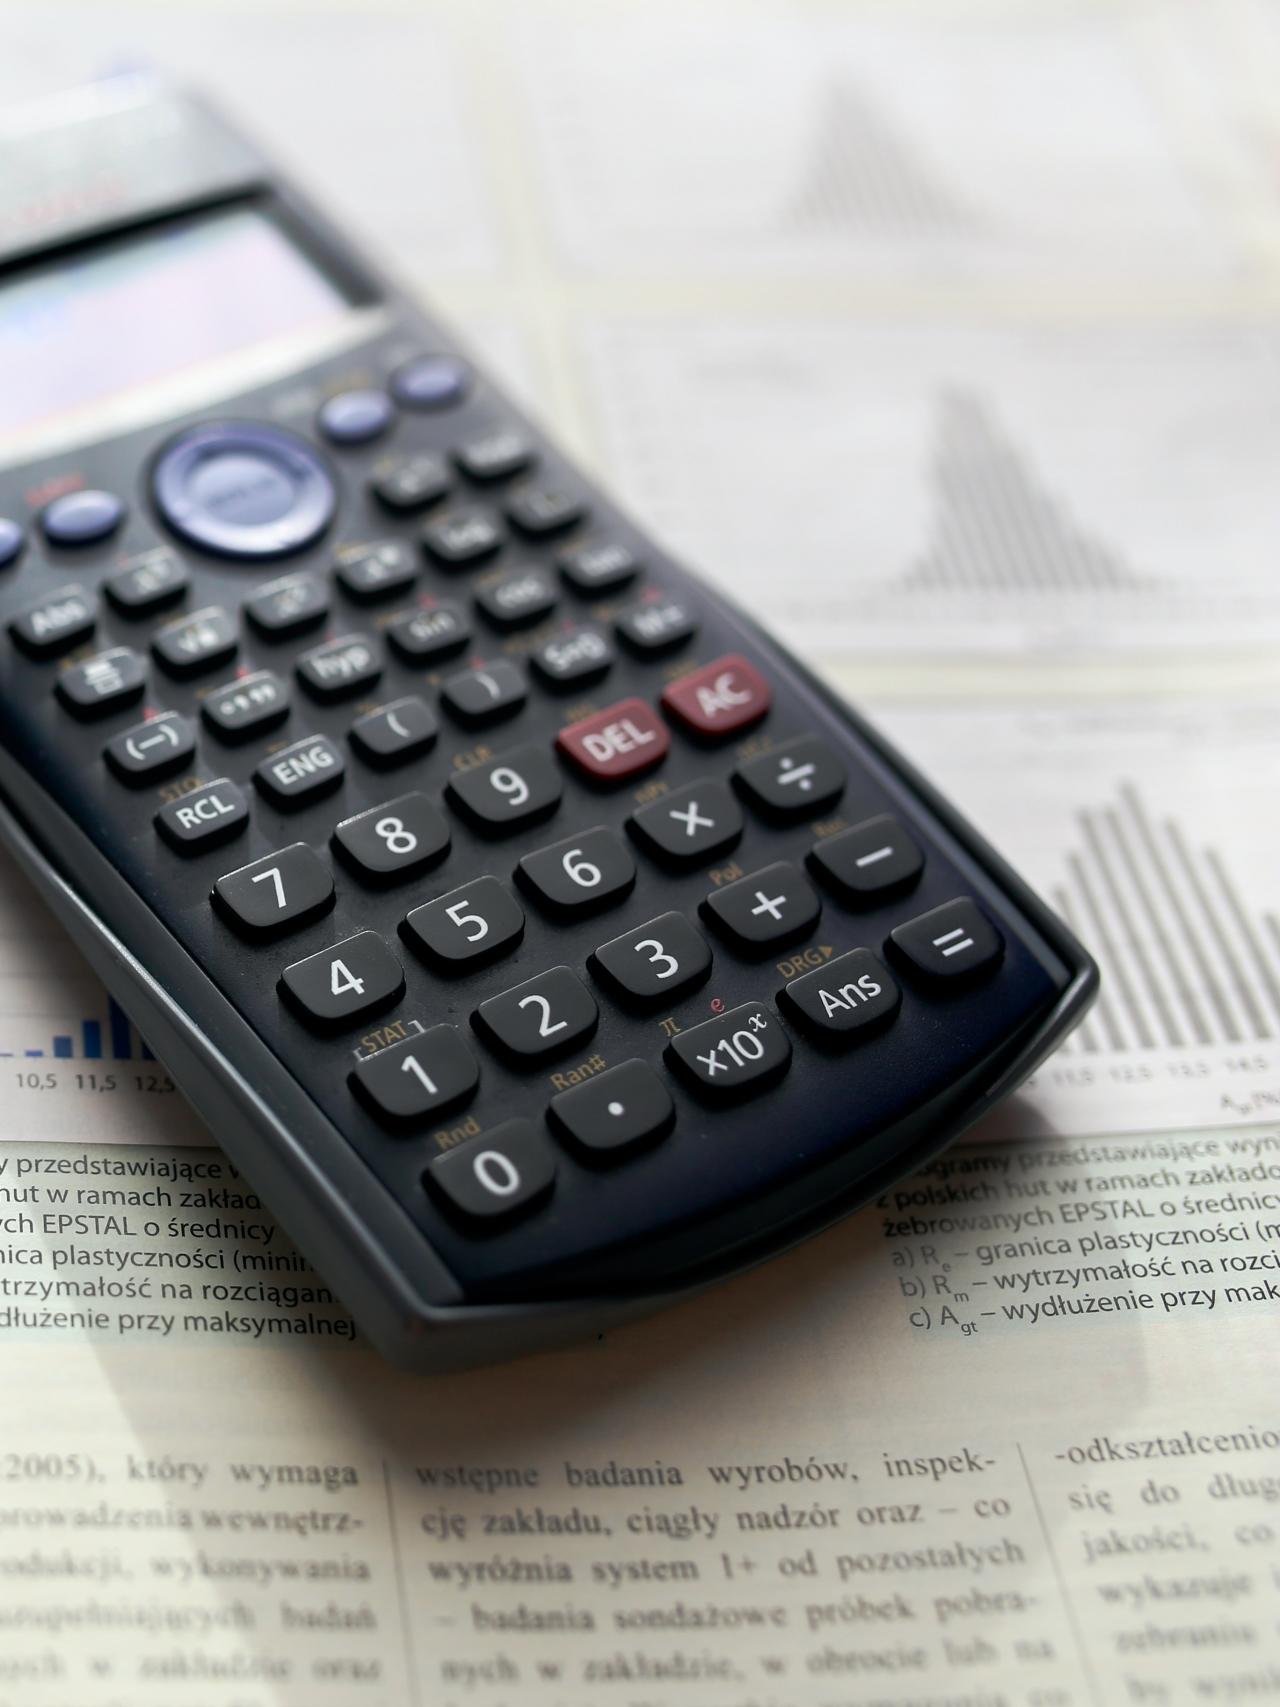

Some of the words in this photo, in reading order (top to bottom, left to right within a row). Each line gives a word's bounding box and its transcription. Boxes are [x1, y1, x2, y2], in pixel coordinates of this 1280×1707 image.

[696, 672, 751, 719] AC
[582, 718, 657, 764] DEL
[272, 746, 334, 785] ENG
[489, 766, 530, 806] 9
[175, 795, 235, 829] RCL
[374, 816, 418, 854] 8
[251, 867, 288, 909] 7
[561, 848, 602, 888] 6
[445, 899, 489, 942] 5
[330, 959, 365, 997] 4
[633, 938, 680, 979] 3
[518, 994, 568, 1038] 2
[818, 973, 882, 1019] Ans
[16, 1073, 57, 1091] 10,5
[75, 1074, 117, 1092] 11,5
[135, 1076, 175, 1094] 12,5
[401, 1055, 438, 1094] 1
[549, 1053, 607, 1091] Ran#
[433, 1117, 482, 1151] Rnd
[1018, 1133, 1218, 1172] przedstawiające
[17, 1154, 221, 1181] przedstawiające
[473, 1150, 520, 1197] 0
[46, 1188, 69, 1204] w
[76, 1185, 172, 1206] ramach
[894, 1180, 999, 1211] polskich
[1005, 1177, 1051, 1199] hut
[1056, 1178, 1079, 1196] w
[1086, 1167, 1181, 1193] ramach
[42, 1213, 137, 1236] EPSTAL
[143, 1220, 160, 1237] o
[167, 1216, 276, 1246] średnicy
[883, 1204, 1054, 1239] żebrowanych
[1059, 1198, 1155, 1225] EPSTAL
[1160, 1200, 1177, 1217] o
[52, 1245, 225, 1271] plastyczności
[892, 1245, 915, 1268] a)
[976, 1237, 1072, 1266] granica
[1078, 1221, 1250, 1258] plastyczności
[161, 1283, 193, 1300] na
[202, 1281, 338, 1308] rozciągan
[899, 1275, 926, 1300] b)
[993, 1256, 1177, 1293] wytrzymałość
[1180, 1256, 1214, 1276] na
[909, 1306, 931, 1330] c)
[1002, 1289, 1154, 1326] wydłużenie
[1160, 1288, 1216, 1312] przy
[1224, 1280, 1280, 1304] mak
[119, 1310, 175, 1336] przy
[183, 1311, 357, 1341] maksymalnej
[127, 1453, 208, 1489] który
[230, 1460, 360, 1493] wymaga
[416, 1463, 540, 1495] wstępne
[564, 1459, 684, 1488] badania
[708, 1456, 859, 1490] wyrobów,
[883, 1447, 997, 1482] inspek-
[1068, 1483, 1115, 1514] się
[1140, 1478, 1180, 1506] do
[200, 1506, 364, 1537] wewnętrz-
[420, 1507, 468, 1541] cję
[482, 1507, 614, 1537] zakładu,
[626, 1506, 719, 1540] ciągły
[736, 1502, 840, 1533] nadzór
[856, 1503, 923, 1527] oraz
[974, 1496, 1011, 1519] co
[1080, 1522, 1211, 1566] jakości,
[426, 1553, 574, 1591] wyróżnia
[591, 1557, 700, 1591] system
[778, 1549, 818, 1579] od
[835, 1538, 1027, 1584] pozostałych
